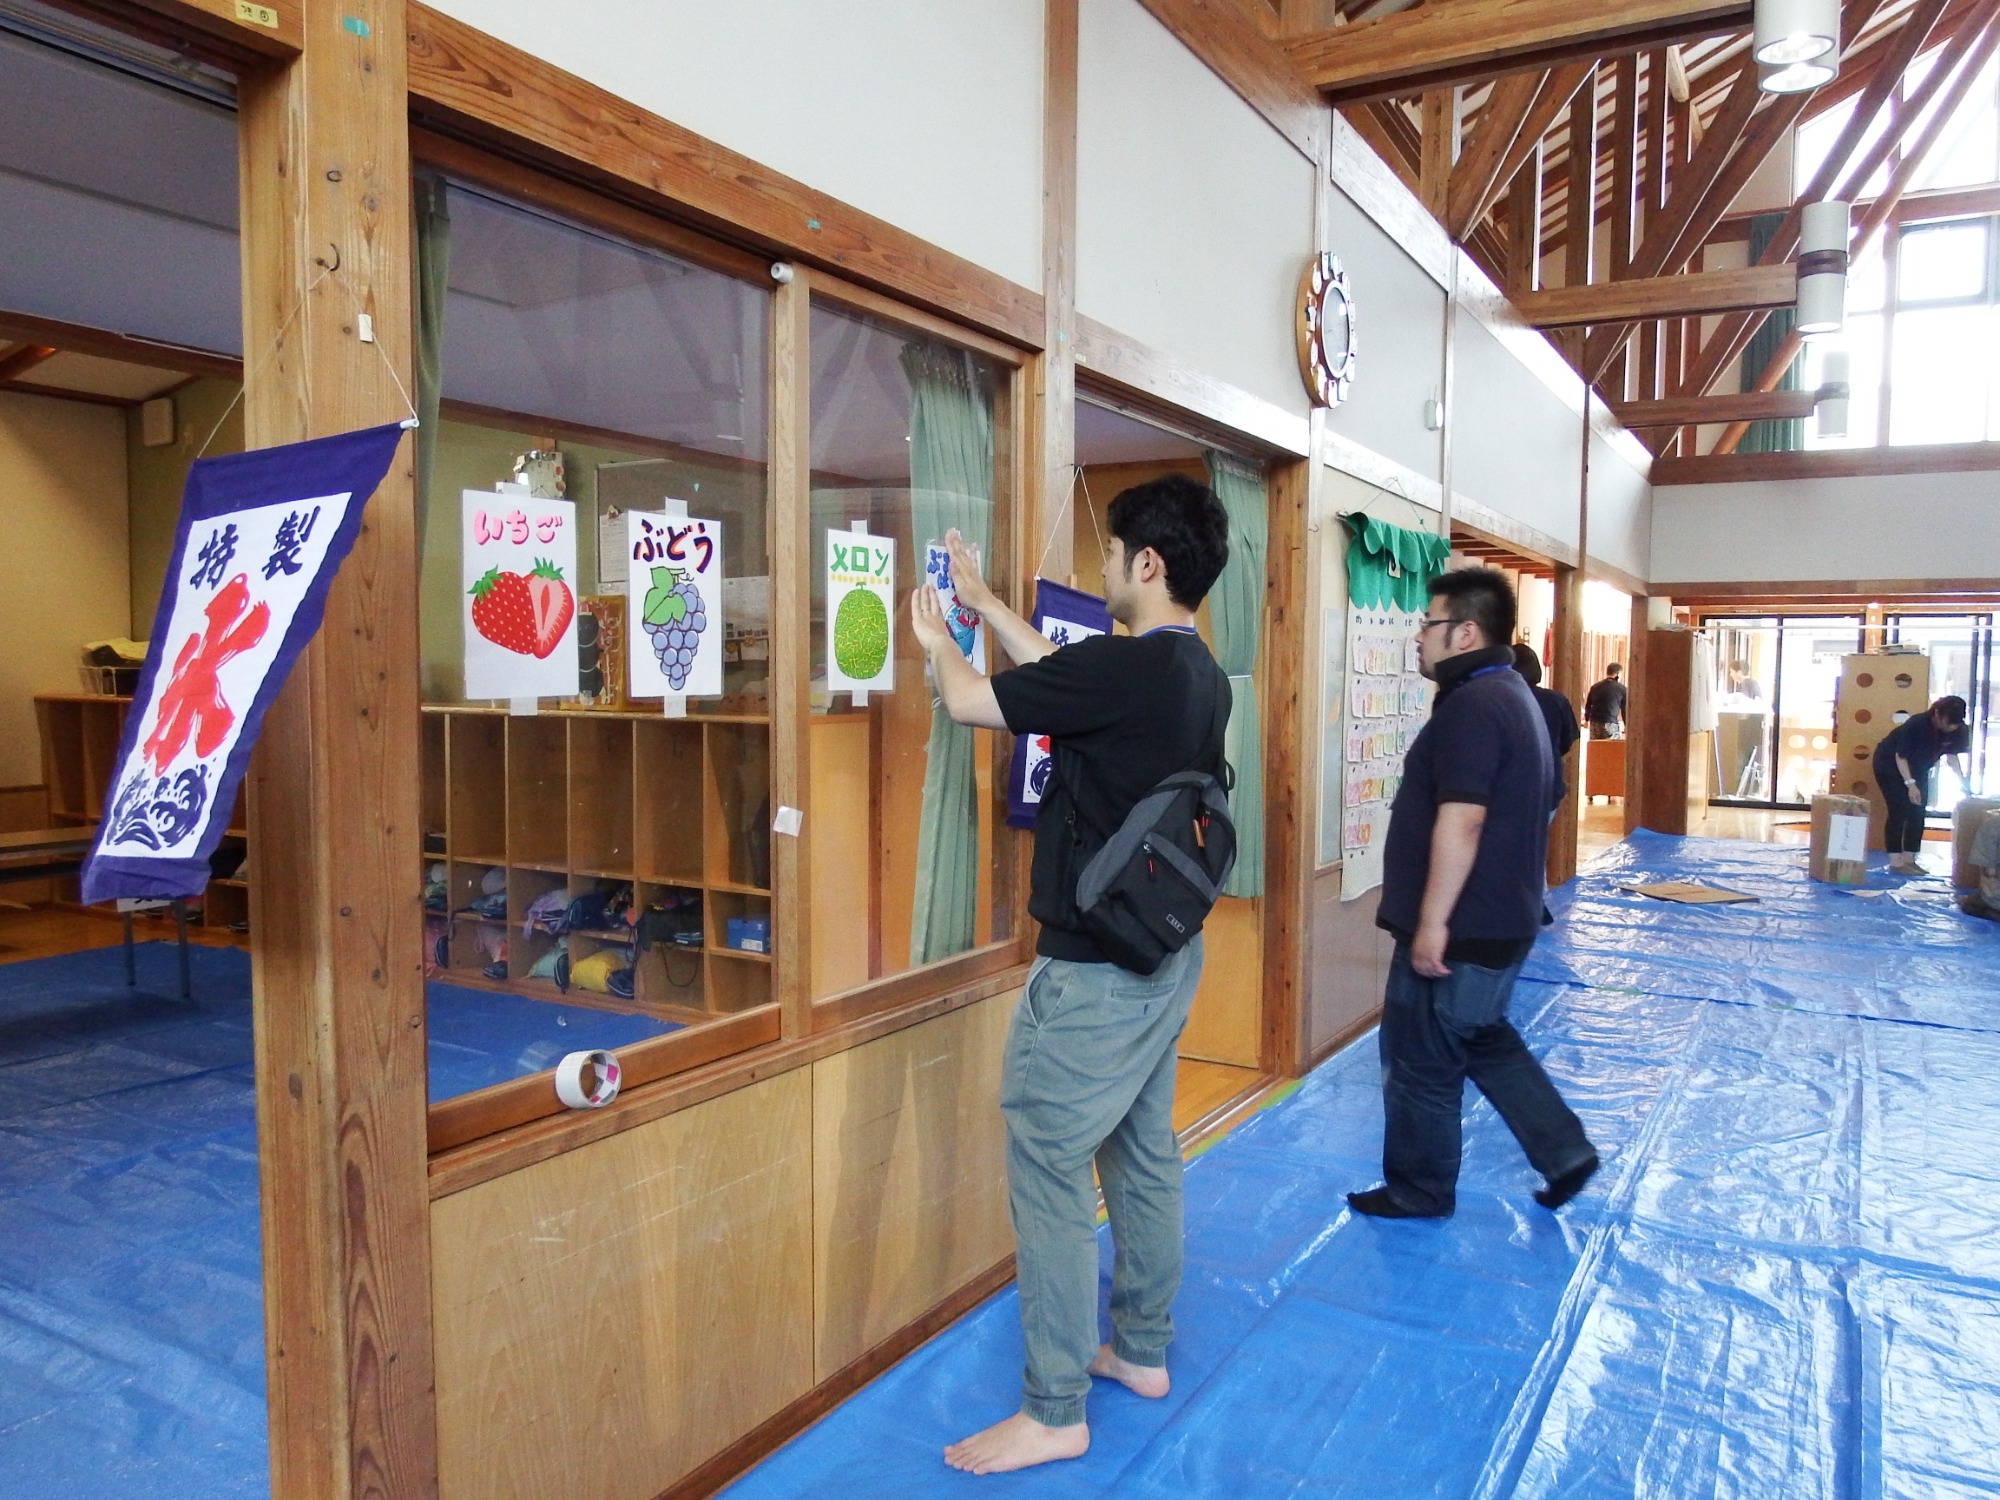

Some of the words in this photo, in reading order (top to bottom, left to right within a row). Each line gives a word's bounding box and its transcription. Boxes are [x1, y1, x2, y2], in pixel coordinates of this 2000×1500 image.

[190, 505, 321, 590] 特製
[472, 509, 563, 546] いちご
[633, 518, 713, 574] ぶどう
[830, 543, 889, 577] メロン
